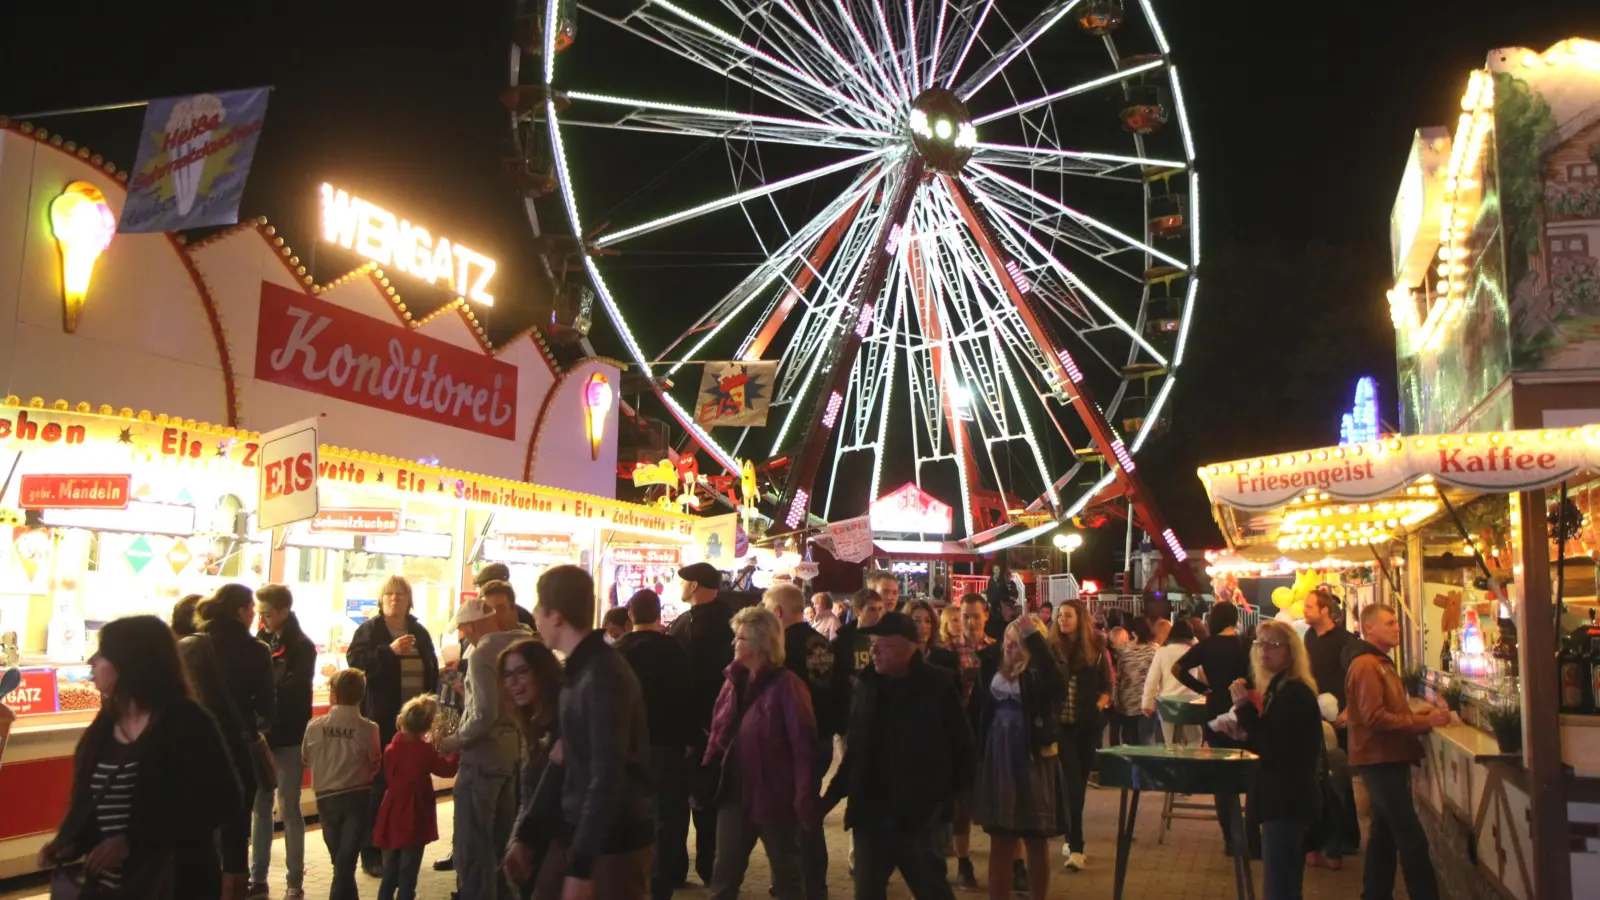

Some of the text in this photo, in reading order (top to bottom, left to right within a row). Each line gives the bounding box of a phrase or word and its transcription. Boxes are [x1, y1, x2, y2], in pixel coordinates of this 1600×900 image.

[320, 181, 497, 307] WENGATZ
[270, 305, 512, 426] Konditorei
[699, 397, 743, 424] EIS
[161, 427, 202, 458] Eis
[396, 469, 426, 493] Eis
[454, 479, 552, 512] Schmalzkuchen
[575, 500, 593, 518] Eis
[264, 452, 314, 501] EIS
[1236, 459, 1375, 494] Friesengeist
[1438, 446, 1556, 473] Kaffee
[29, 480, 121, 502] gebr. Mandeln
